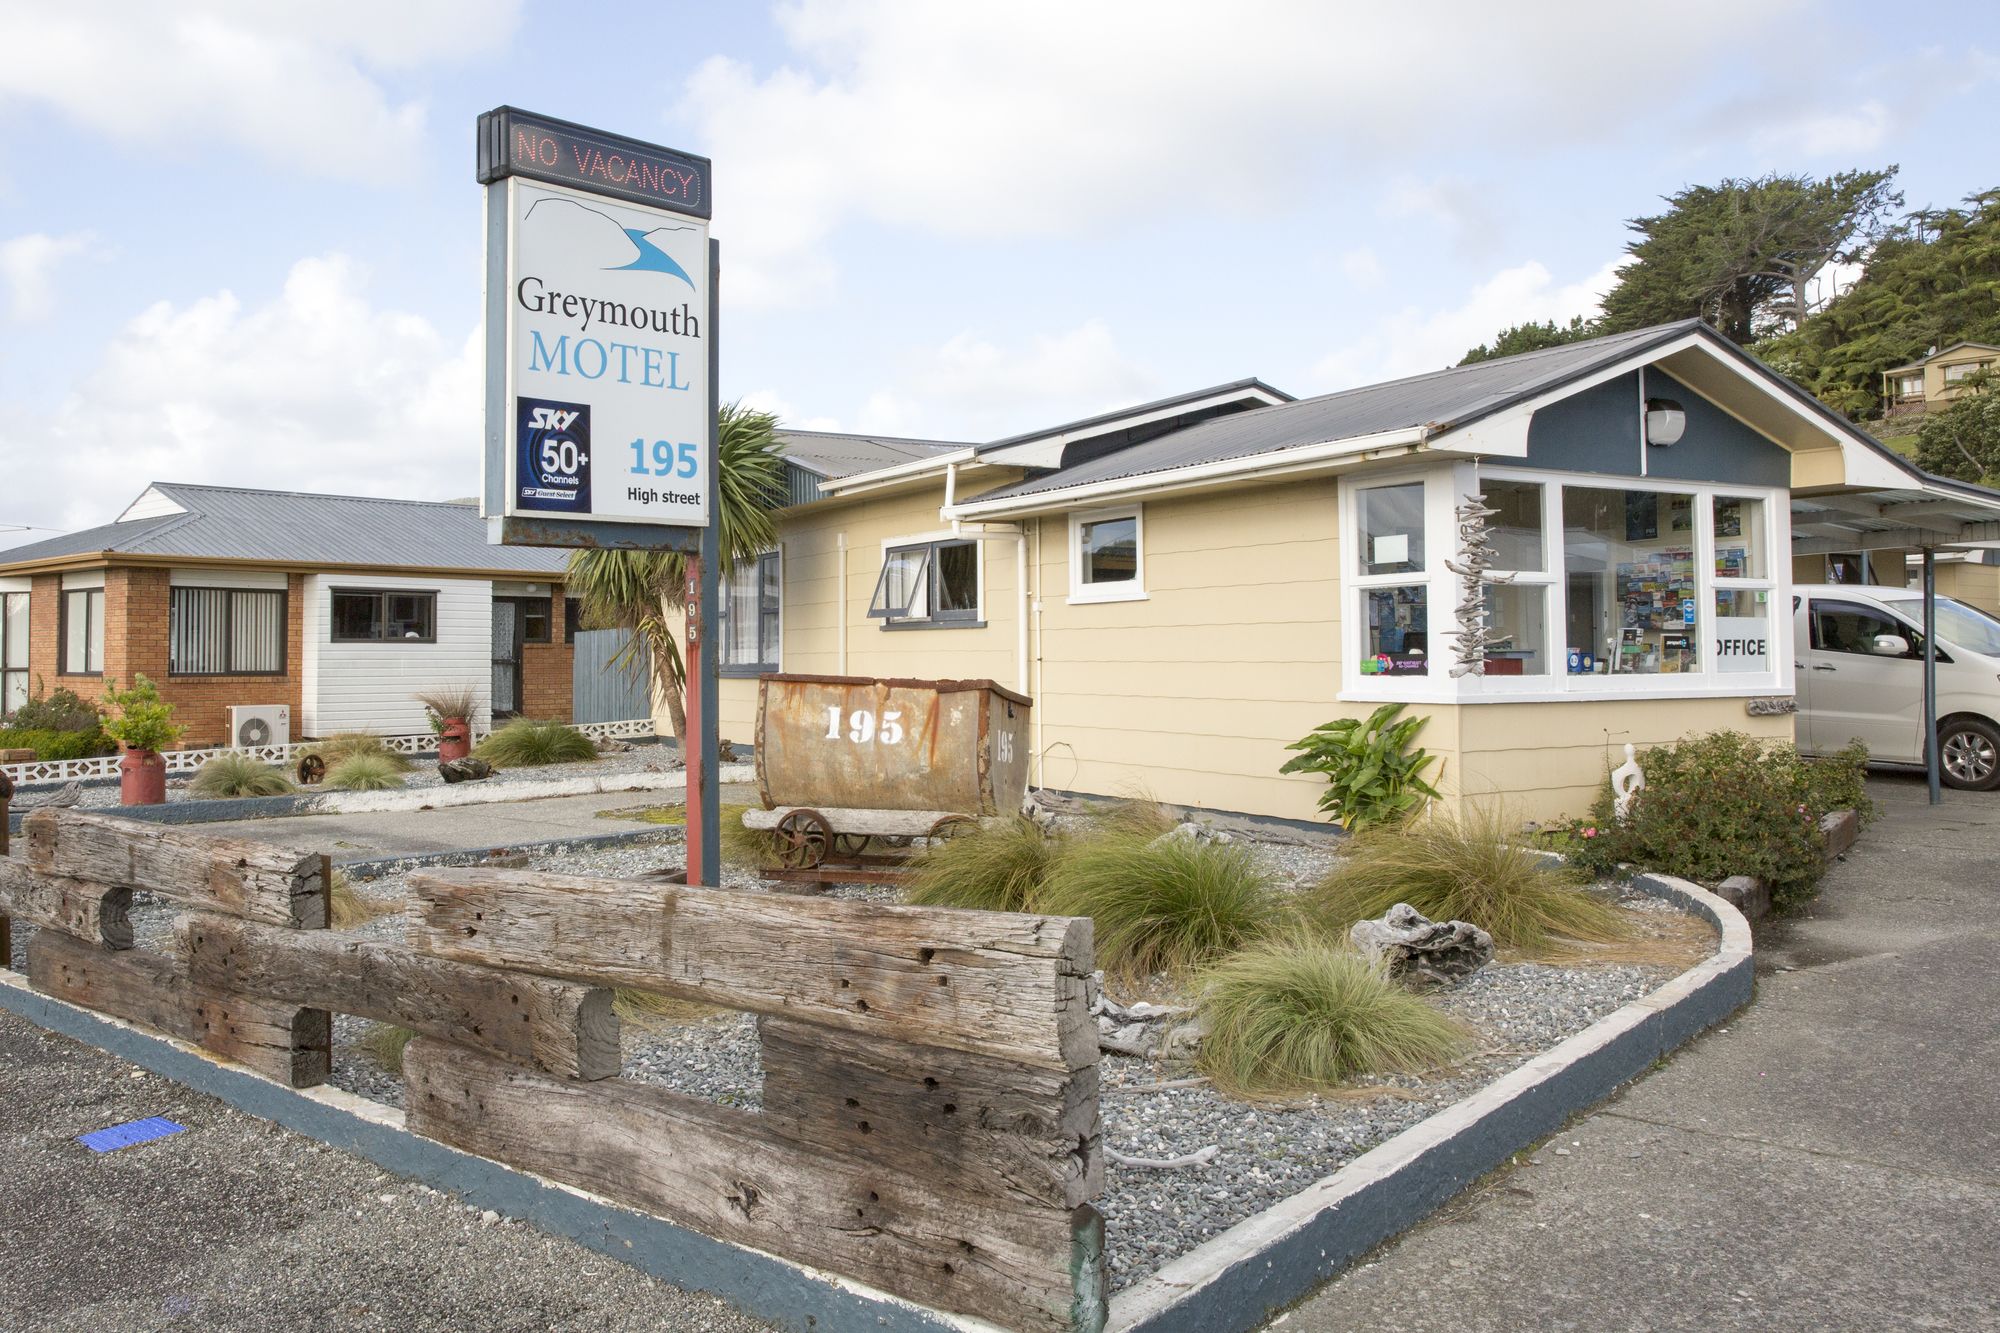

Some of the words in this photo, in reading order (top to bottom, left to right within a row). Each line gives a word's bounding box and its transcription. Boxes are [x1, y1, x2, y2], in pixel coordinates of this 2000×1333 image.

[518, 132, 557, 166] NO
[573, 145, 693, 198] VACANCY
[517, 277, 701, 338] Greymouth
[528, 330, 690, 391] MOTEL
[528, 407, 579, 432] SKY
[541, 439, 588, 474] 50+
[630, 438, 698, 479] 195
[541, 473, 579, 485] Channels
[556, 491, 574, 499] Select
[627, 487, 658, 505] High
[662, 490, 701, 505] street
[825, 706, 903, 745] 195
[997, 729, 1013, 763] 195
